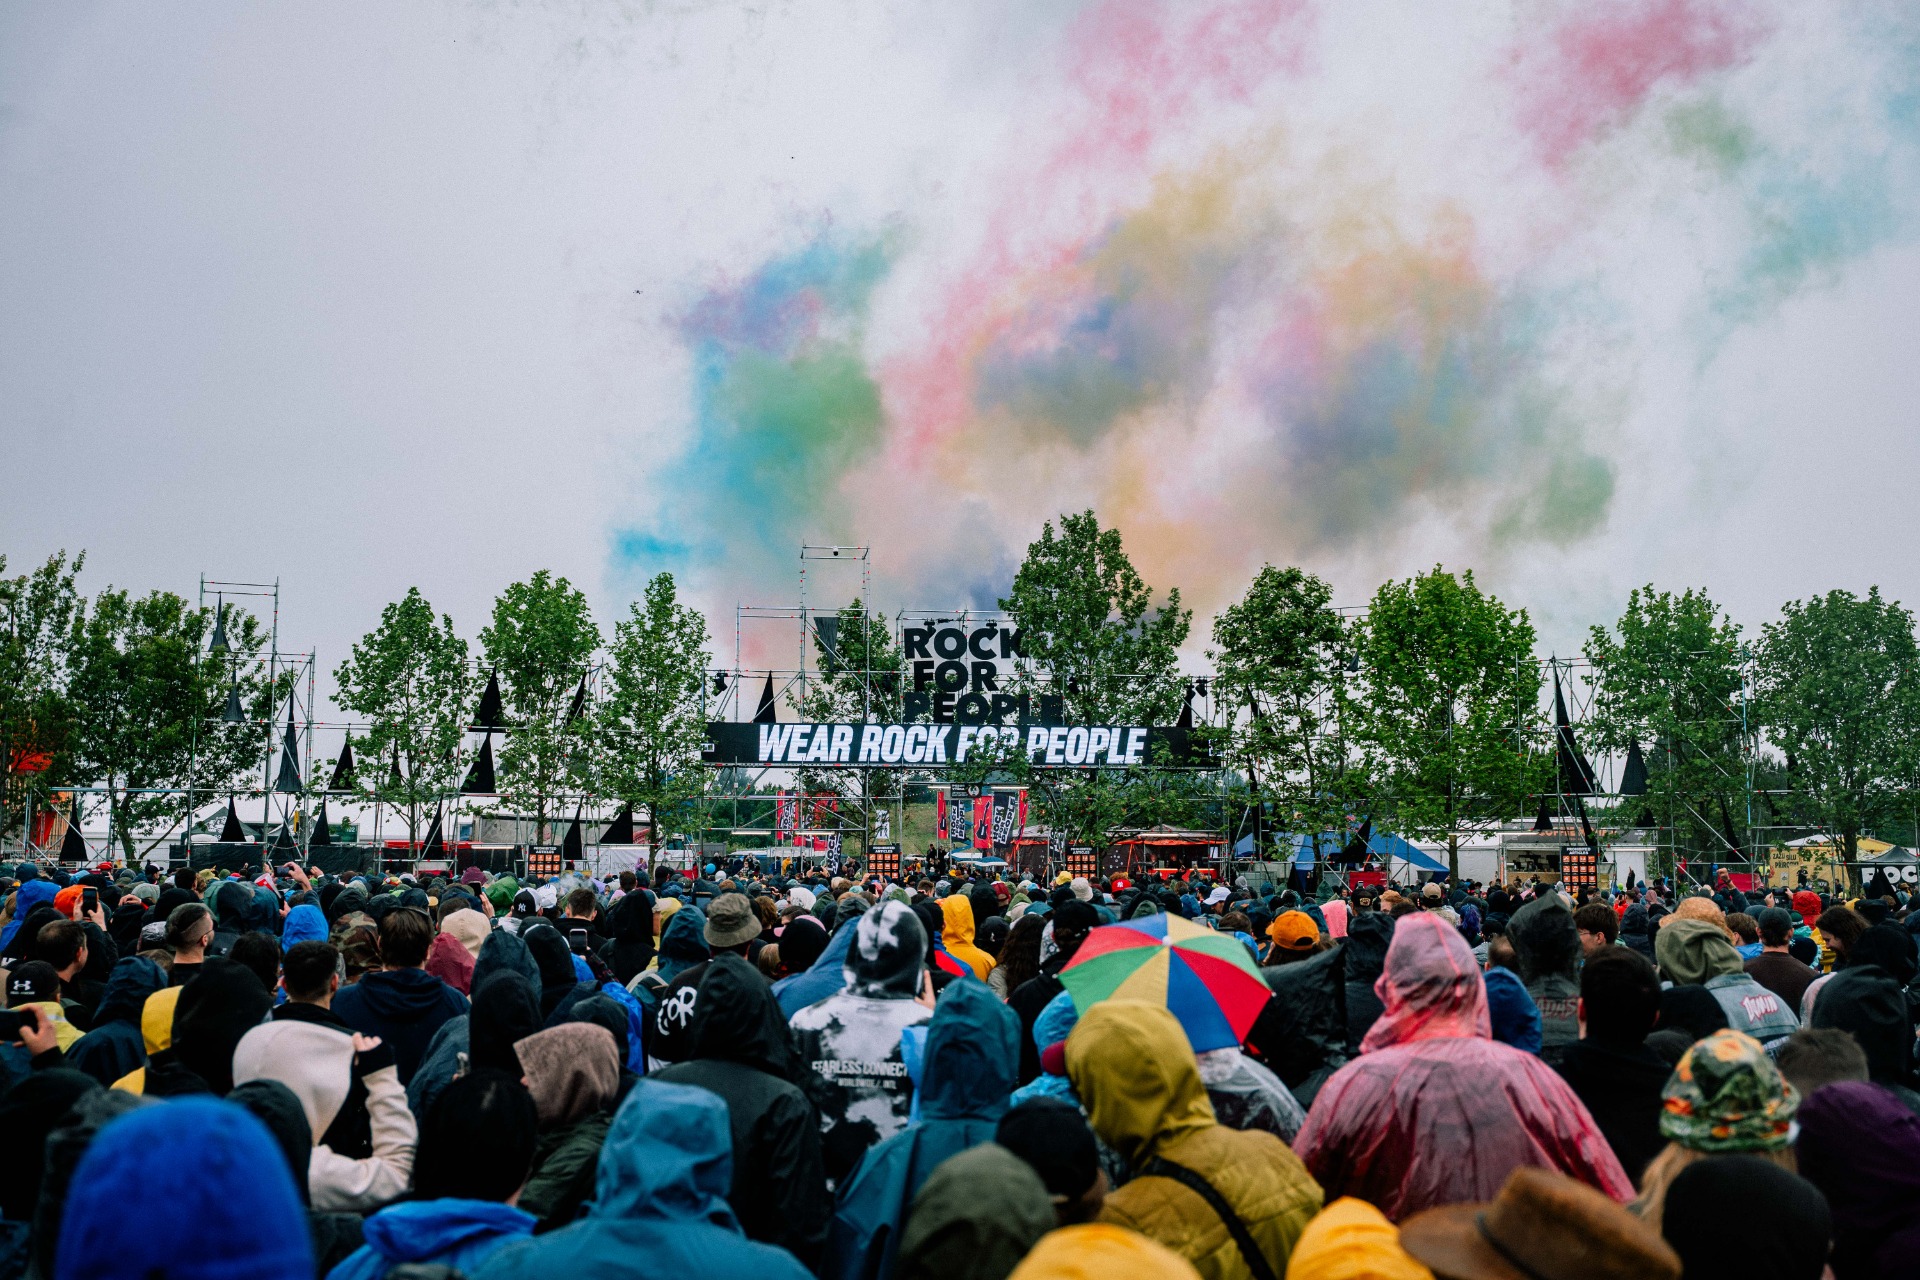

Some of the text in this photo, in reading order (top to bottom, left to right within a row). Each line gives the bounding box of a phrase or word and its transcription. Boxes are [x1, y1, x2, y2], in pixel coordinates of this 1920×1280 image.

[904, 627, 1030, 660] ROCK
[913, 660, 999, 692] FOR
[903, 692, 1064, 724] PEOPLE
[758, 724, 1147, 765] WEAR ROCK FOR PEOPLE
[993, 807, 1004, 840] ROCK
[811, 1060, 862, 1075] FEARLESS
